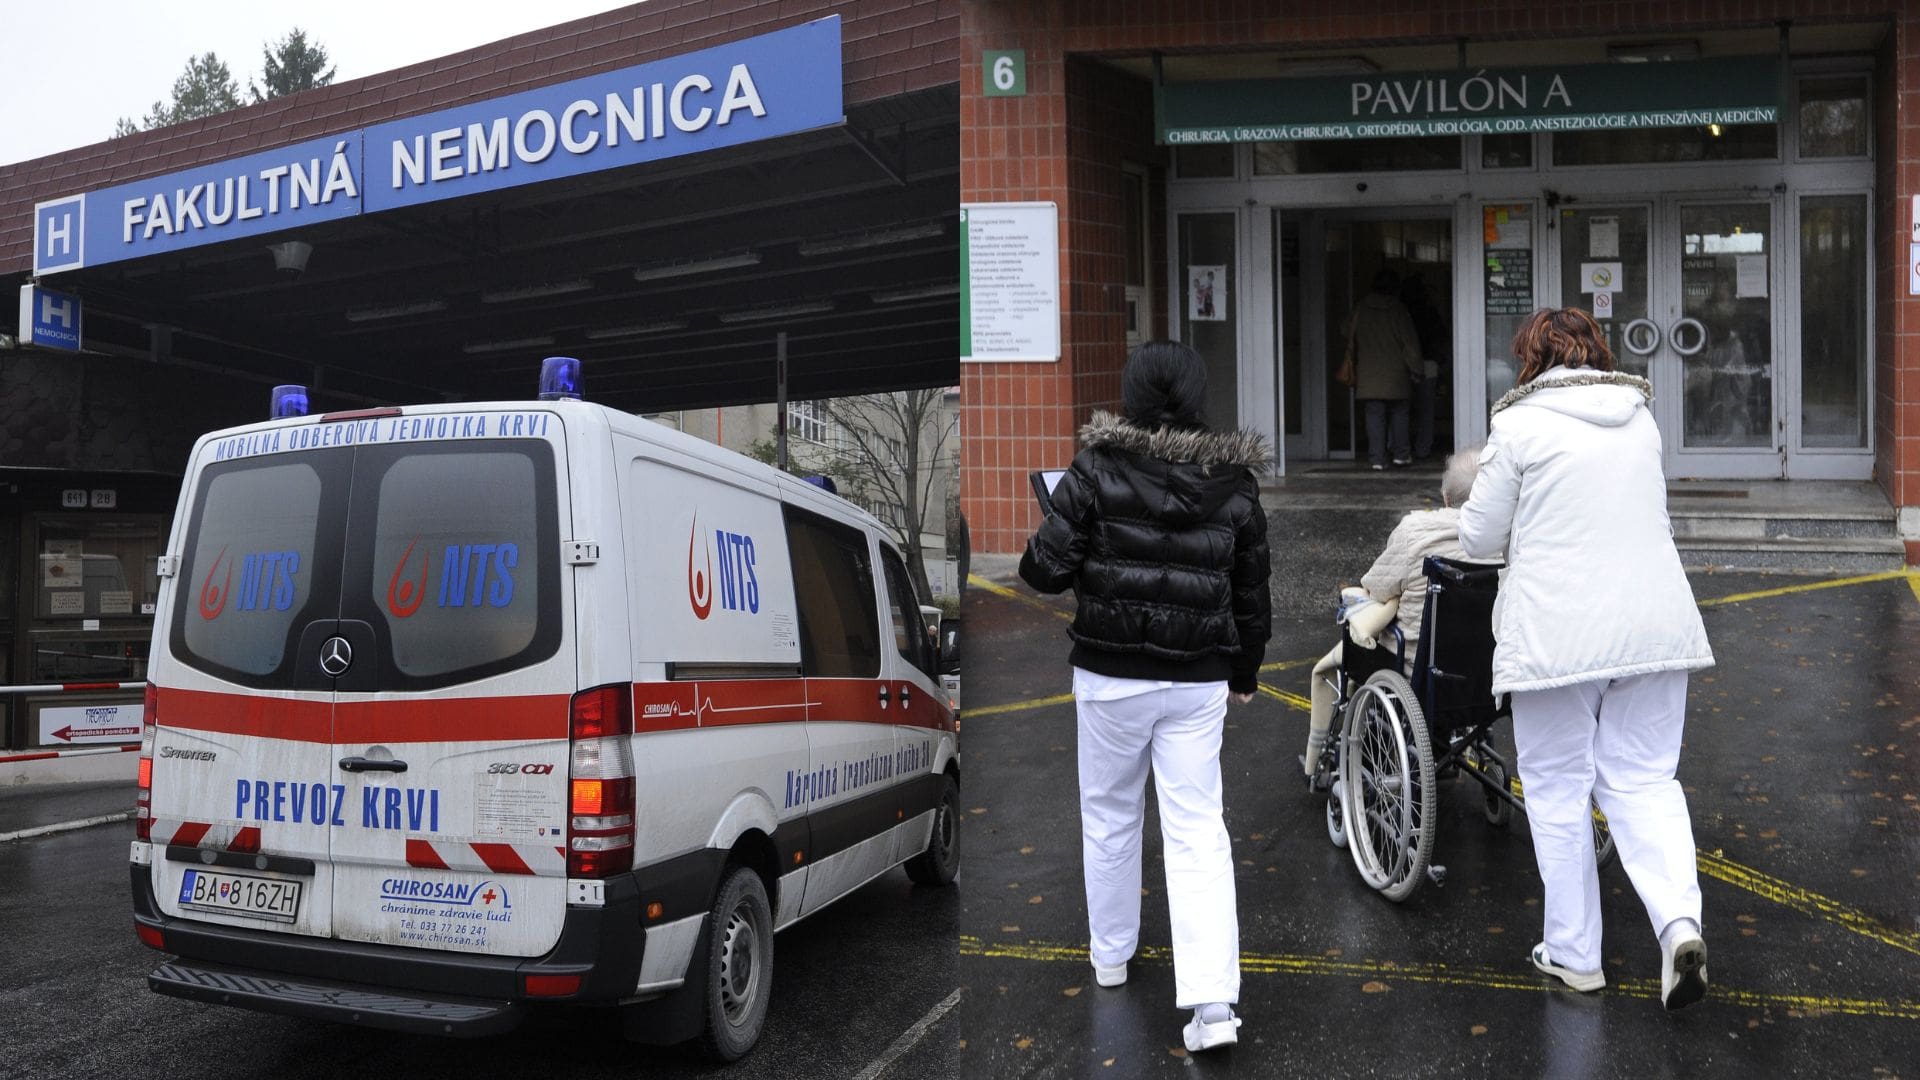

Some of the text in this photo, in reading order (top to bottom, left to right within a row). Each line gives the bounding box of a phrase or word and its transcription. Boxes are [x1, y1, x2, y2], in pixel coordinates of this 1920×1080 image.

[993, 56, 1015, 90] 6
[1351, 69, 1572, 116] PAVILÓN A
[1168, 129, 1231, 144] CHIRURGIA,
[1234, 125, 1288, 141] ÚRAZOVÁ
[1290, 124, 1354, 139] CHIRURGIA,
[1428, 117, 1493, 135] UROLÓGIA,
[1496, 119, 1528, 132] ODD.
[1530, 112, 1627, 130] ANESTEZIOLÓGIE
[1629, 115, 1638, 126] A
[1640, 110, 1713, 126] INTENZÍVNEJ
[1715, 108, 1776, 123] MEDICÍNY
[123, 63, 767, 243] FAKULTNÁ NEMOCNICA
[47, 213, 71, 257] H
[42, 295, 71, 328] H
[34, 327, 77, 342] NEMOCNICA
[216, 414, 548, 461] MOBILNÁ ODBEROVÁ JEDNOTKA KRVI
[236, 551, 300, 611] NTS
[438, 542, 519, 608] NTS
[716, 529, 759, 615] NTS
[644, 704, 671, 714] CHIROSAN
[487, 762, 554, 775] 313 CDI
[784, 761, 838, 809] Národná
[236, 779, 345, 826] PREVOZ
[362, 786, 439, 832] KRVI
[194, 875, 296, 913] BA 816ZH
[382, 879, 469, 899] CHIROSAN
[381, 902, 512, 923] chránime zdravie ľudí
[400, 920, 487, 936] Tel. 033 77 26 241
[400, 931, 486, 946] www.chirosan.sk
